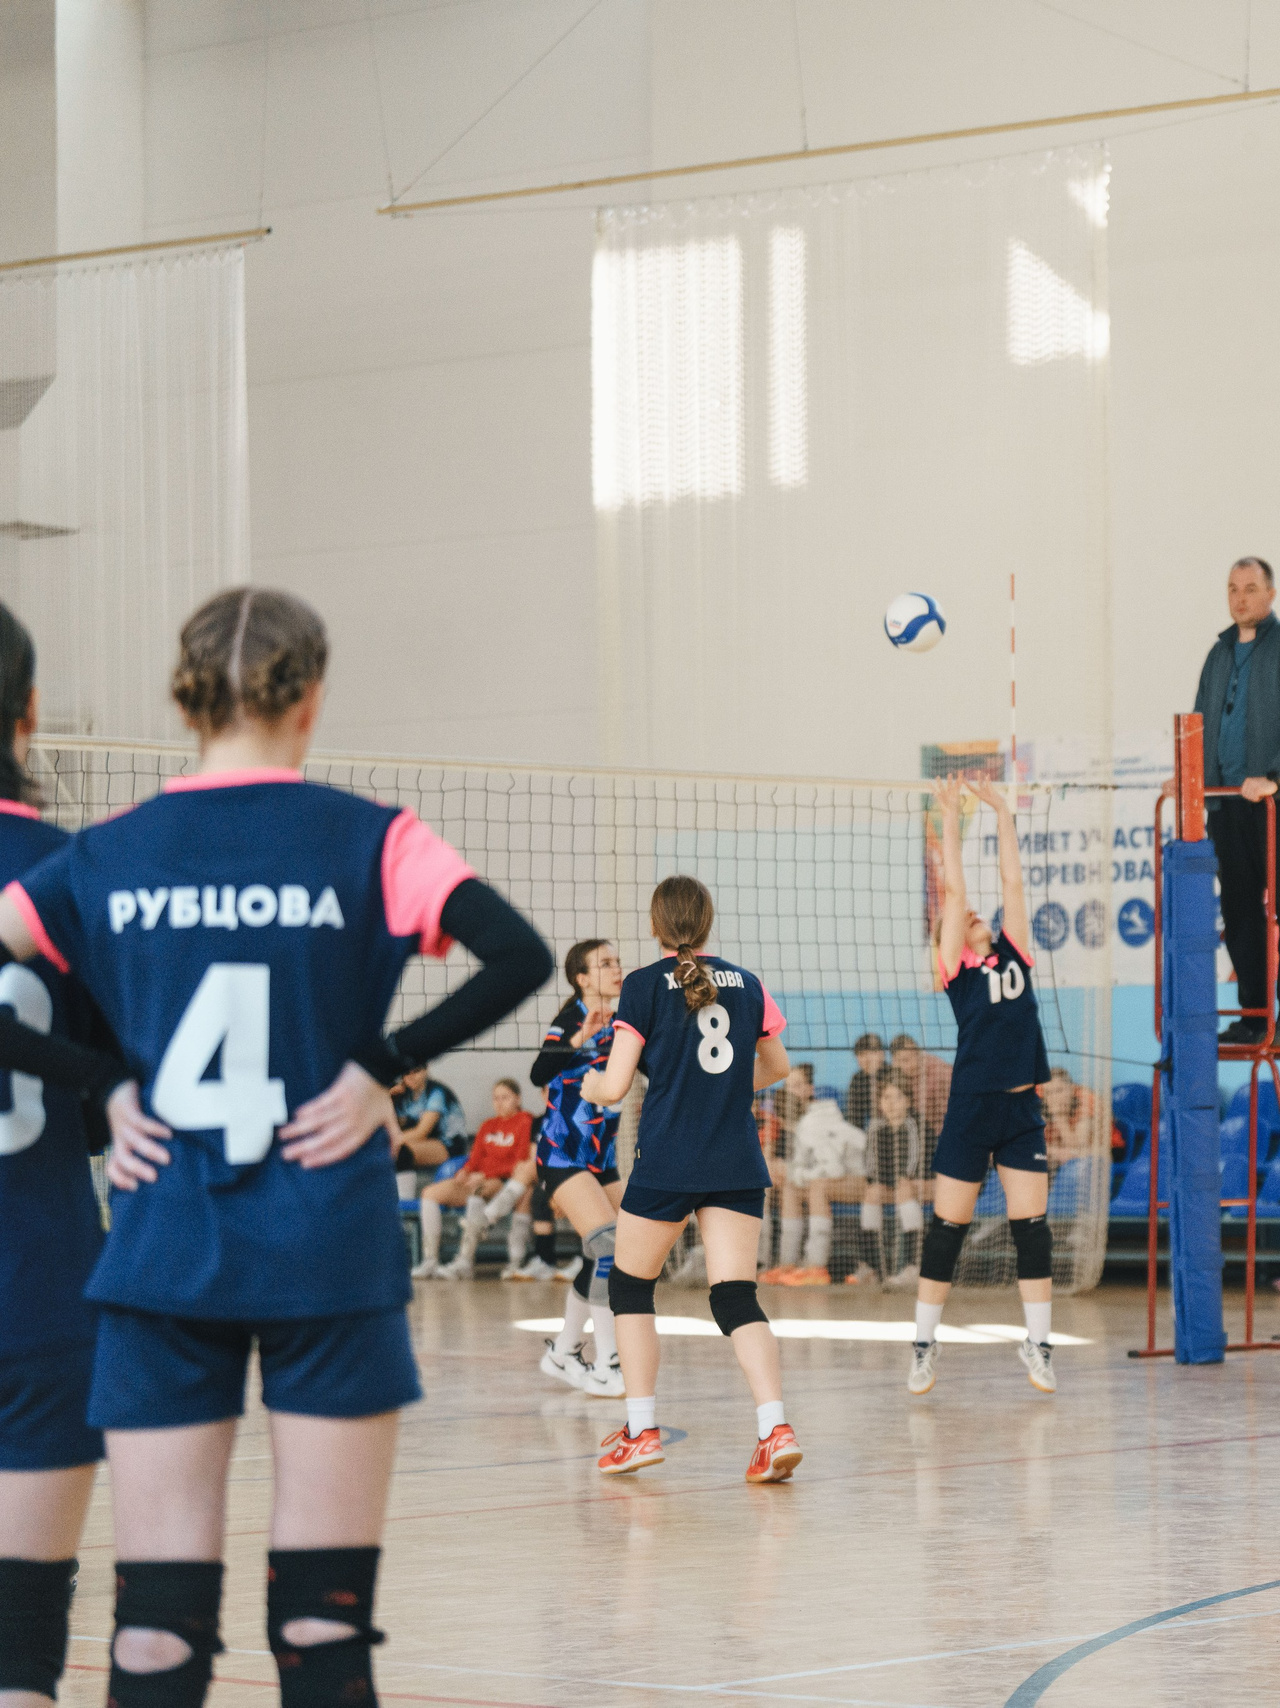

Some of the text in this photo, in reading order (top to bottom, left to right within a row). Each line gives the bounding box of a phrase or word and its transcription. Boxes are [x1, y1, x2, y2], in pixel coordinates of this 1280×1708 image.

[984, 831, 1070, 856] ПИВЕТ
[107, 884, 345, 934] РУБЦОВА
[981, 960, 1026, 1004] 10
[153, 962, 288, 1166] 4
[697, 1003, 734, 1075] 8
